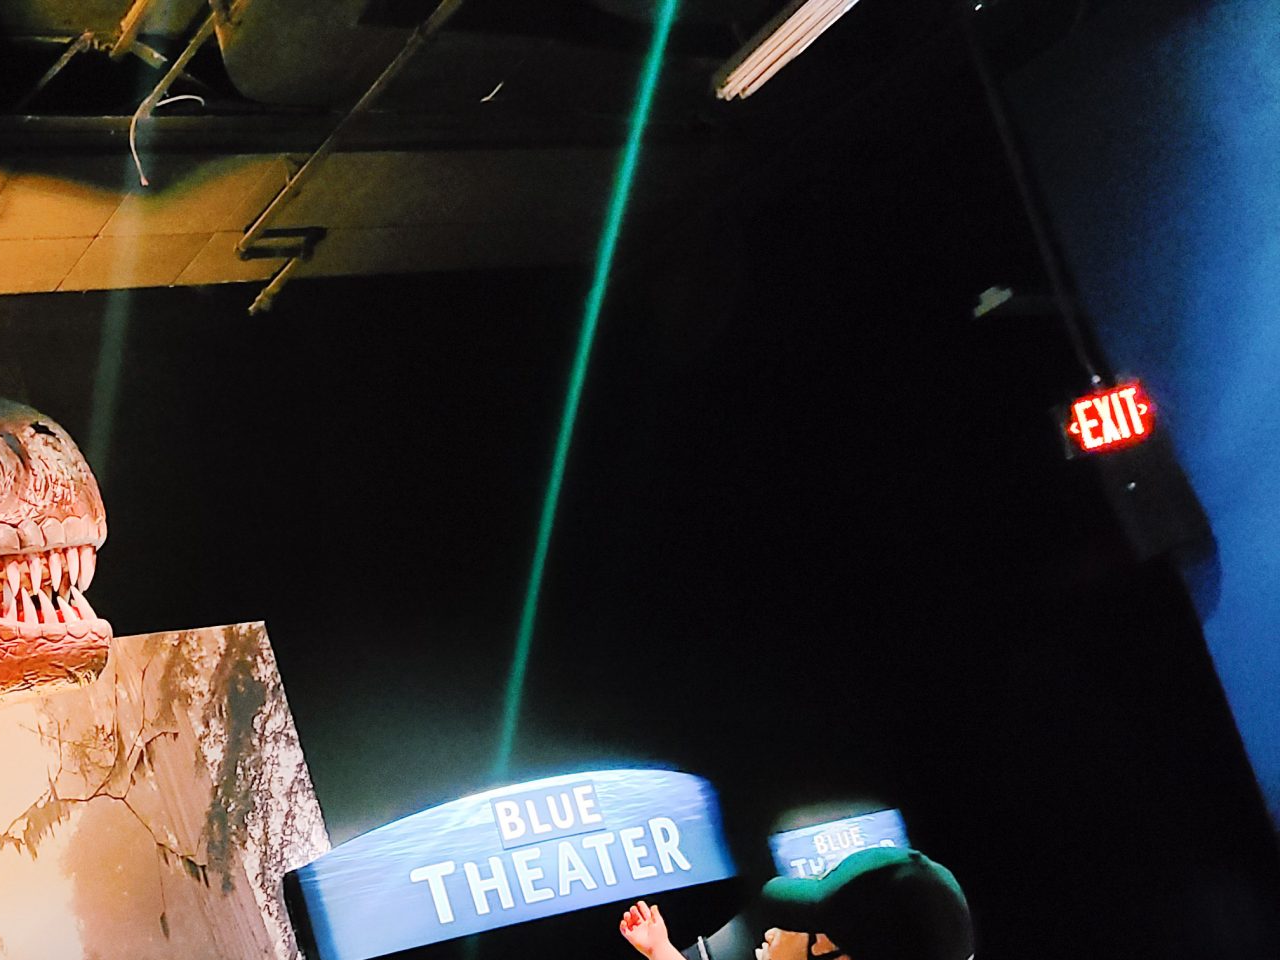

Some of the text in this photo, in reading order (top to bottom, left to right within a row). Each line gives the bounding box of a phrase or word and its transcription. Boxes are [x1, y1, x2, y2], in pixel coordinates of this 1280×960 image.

[1074, 388, 1144, 448] EXIT
[494, 784, 602, 840] BLUE
[813, 826, 865, 854] BLUE
[410, 817, 691, 924] THEATER
